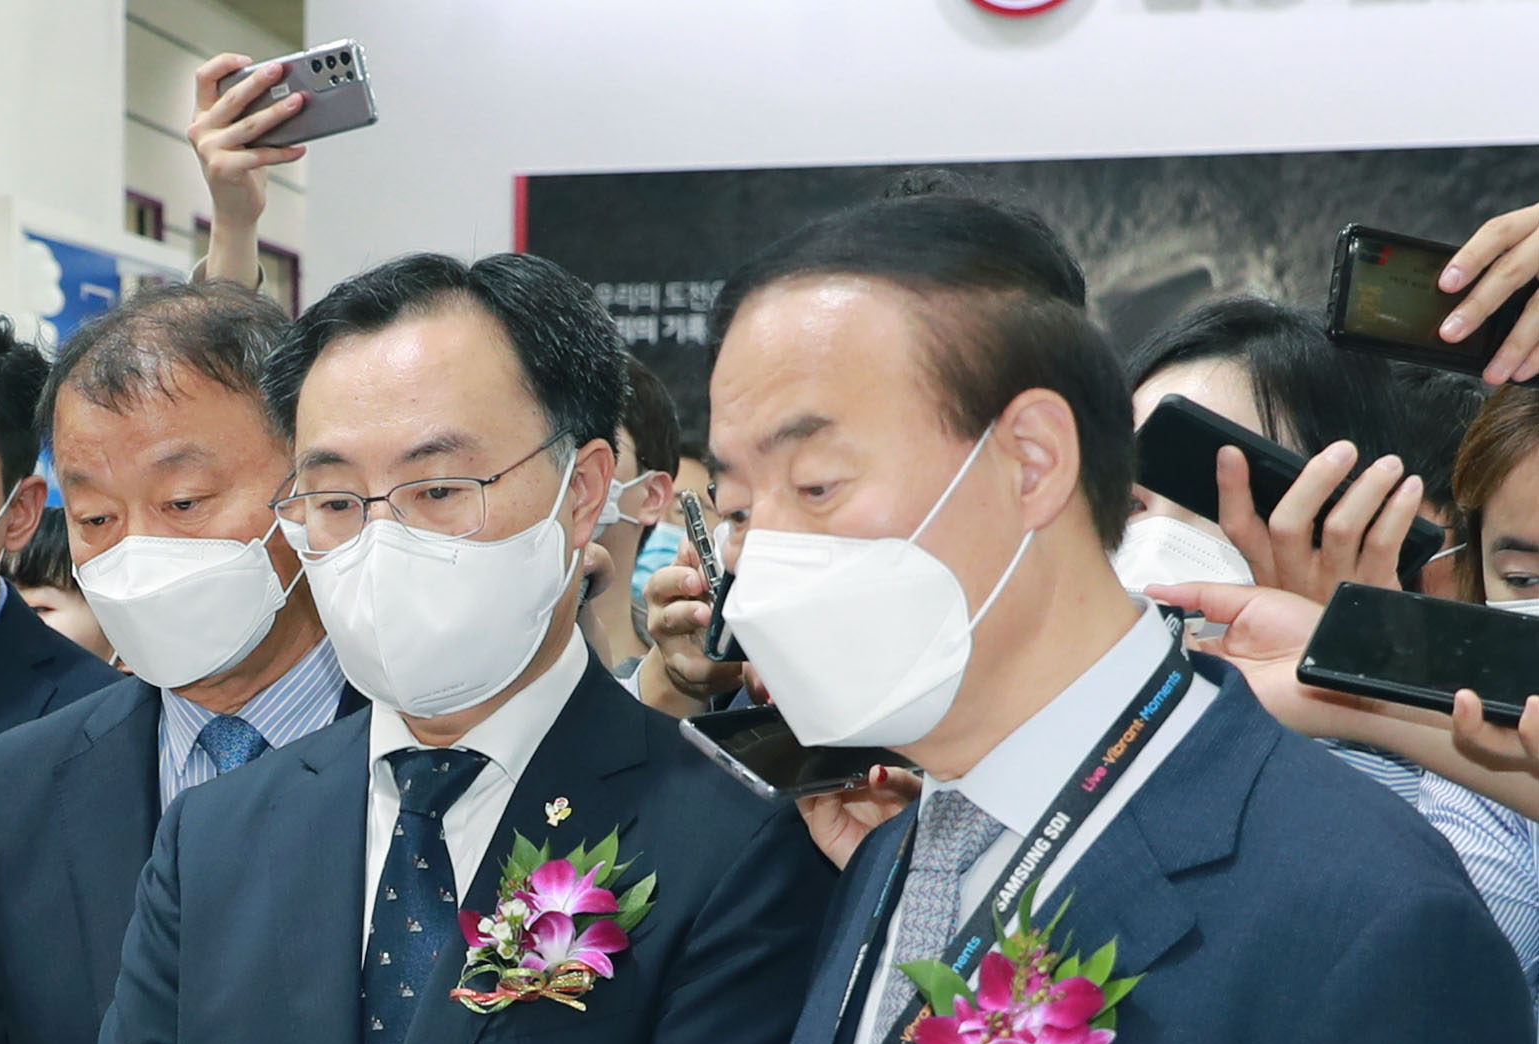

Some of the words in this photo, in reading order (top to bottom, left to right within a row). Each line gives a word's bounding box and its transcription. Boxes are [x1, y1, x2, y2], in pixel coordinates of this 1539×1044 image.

[1081, 765, 1109, 792] Live
[1102, 718, 1145, 764] Vibrant
[1139, 670, 1182, 721] Moments
[996, 838, 1051, 913] SAMSUNG
[1043, 811, 1071, 839] SDI
